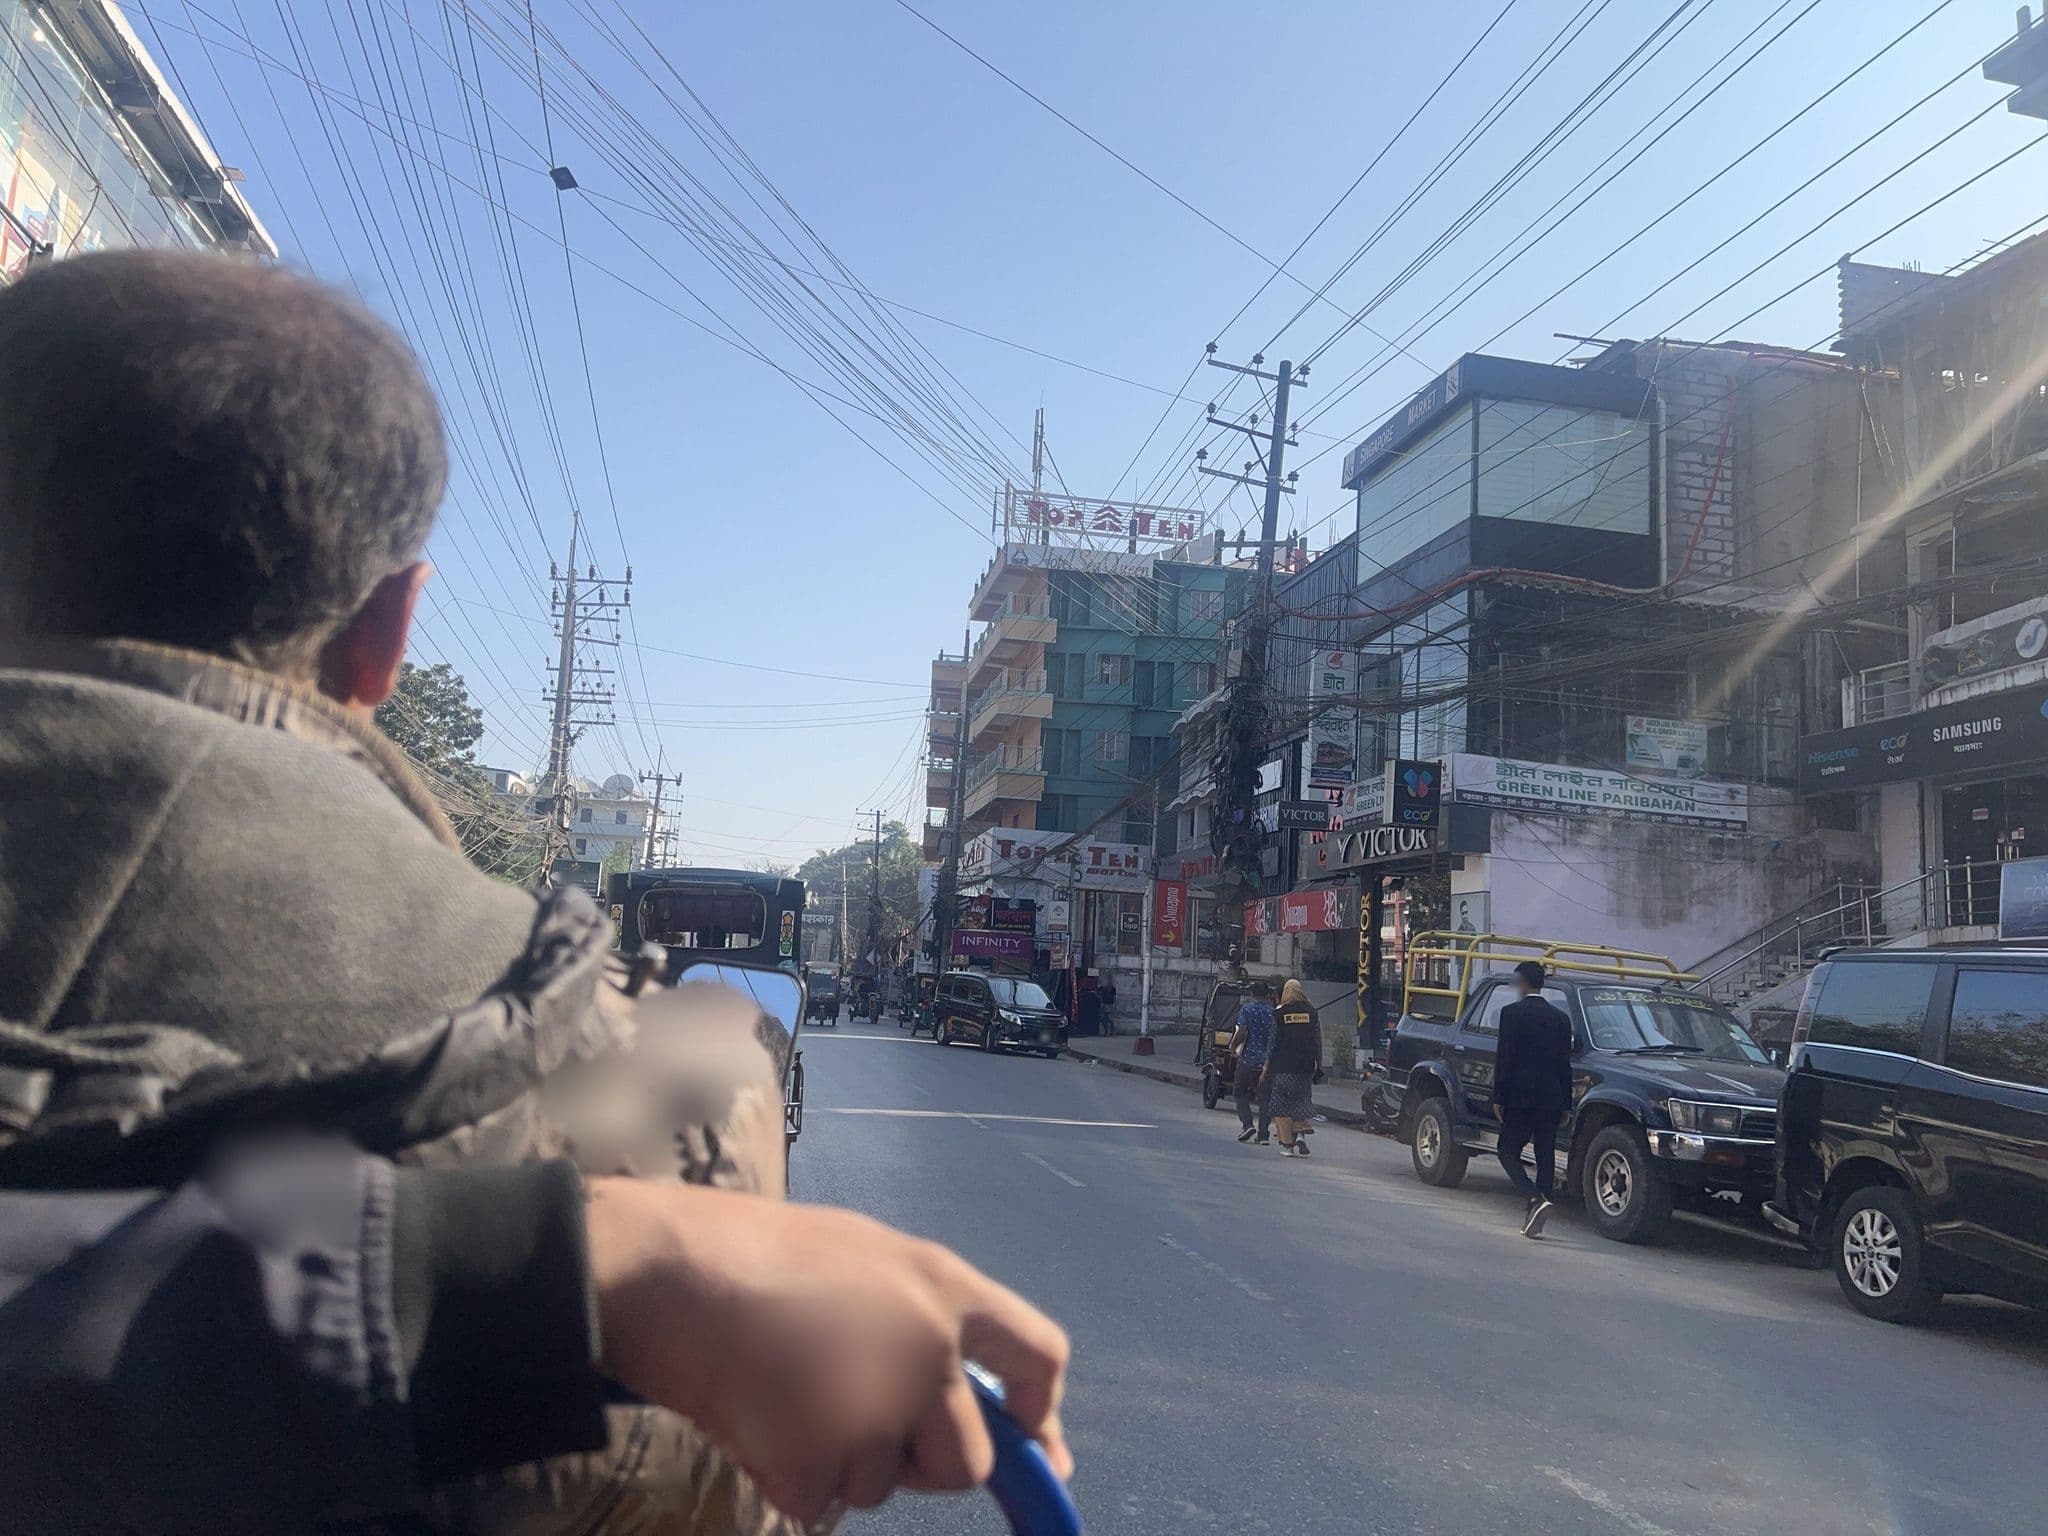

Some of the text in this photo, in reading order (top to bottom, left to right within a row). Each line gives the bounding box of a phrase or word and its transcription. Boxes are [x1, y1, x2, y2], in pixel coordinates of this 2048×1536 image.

[1360, 389, 1437, 465] SINGAPORE MARKET
[1933, 717, 2002, 743] SAMSUNG
[1808, 747, 1859, 765] Hisense
[1496, 780, 1554, 797] GREEN
[1558, 788, 1598, 802] LINE
[1602, 792, 1696, 812] PARIBAHAN
[1281, 808, 1326, 822] VICTOR
[1403, 809, 1430, 822] eco
[1357, 826, 1429, 860] VICTOR
[962, 935, 1021, 949] INFINITY
